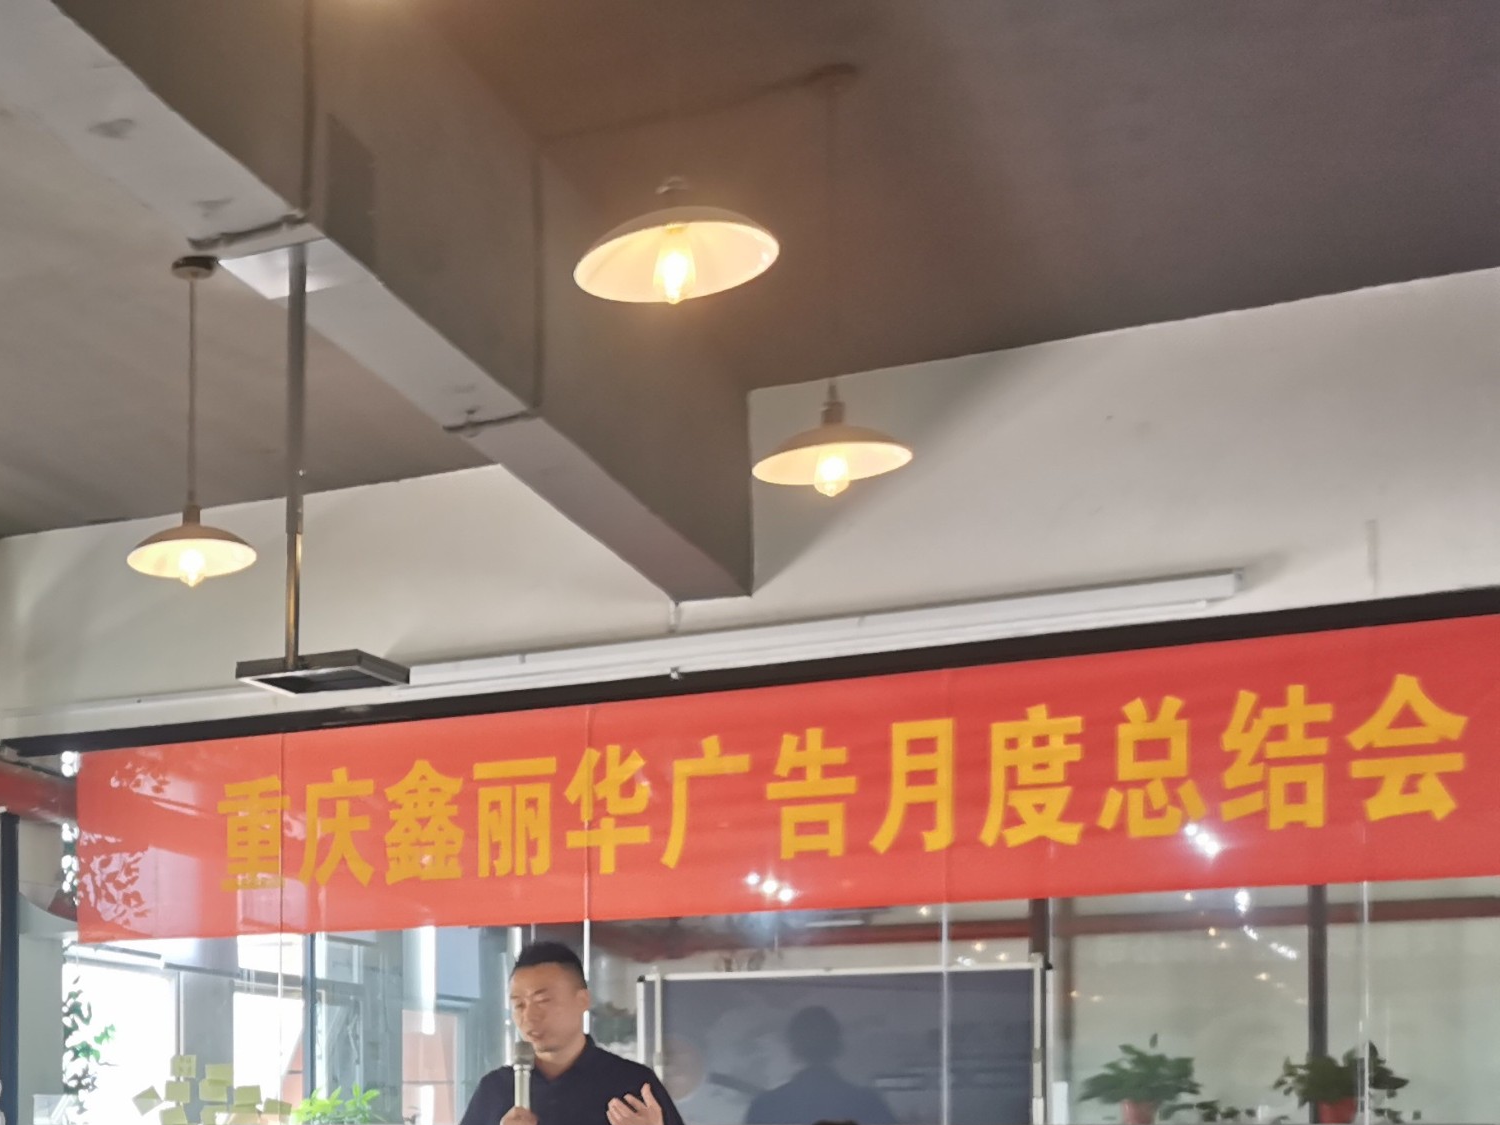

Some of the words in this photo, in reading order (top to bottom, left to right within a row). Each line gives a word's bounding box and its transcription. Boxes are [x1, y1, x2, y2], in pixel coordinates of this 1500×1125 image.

[218, 674, 1468, 891] 重庆鑫丽华广告月度总结会
